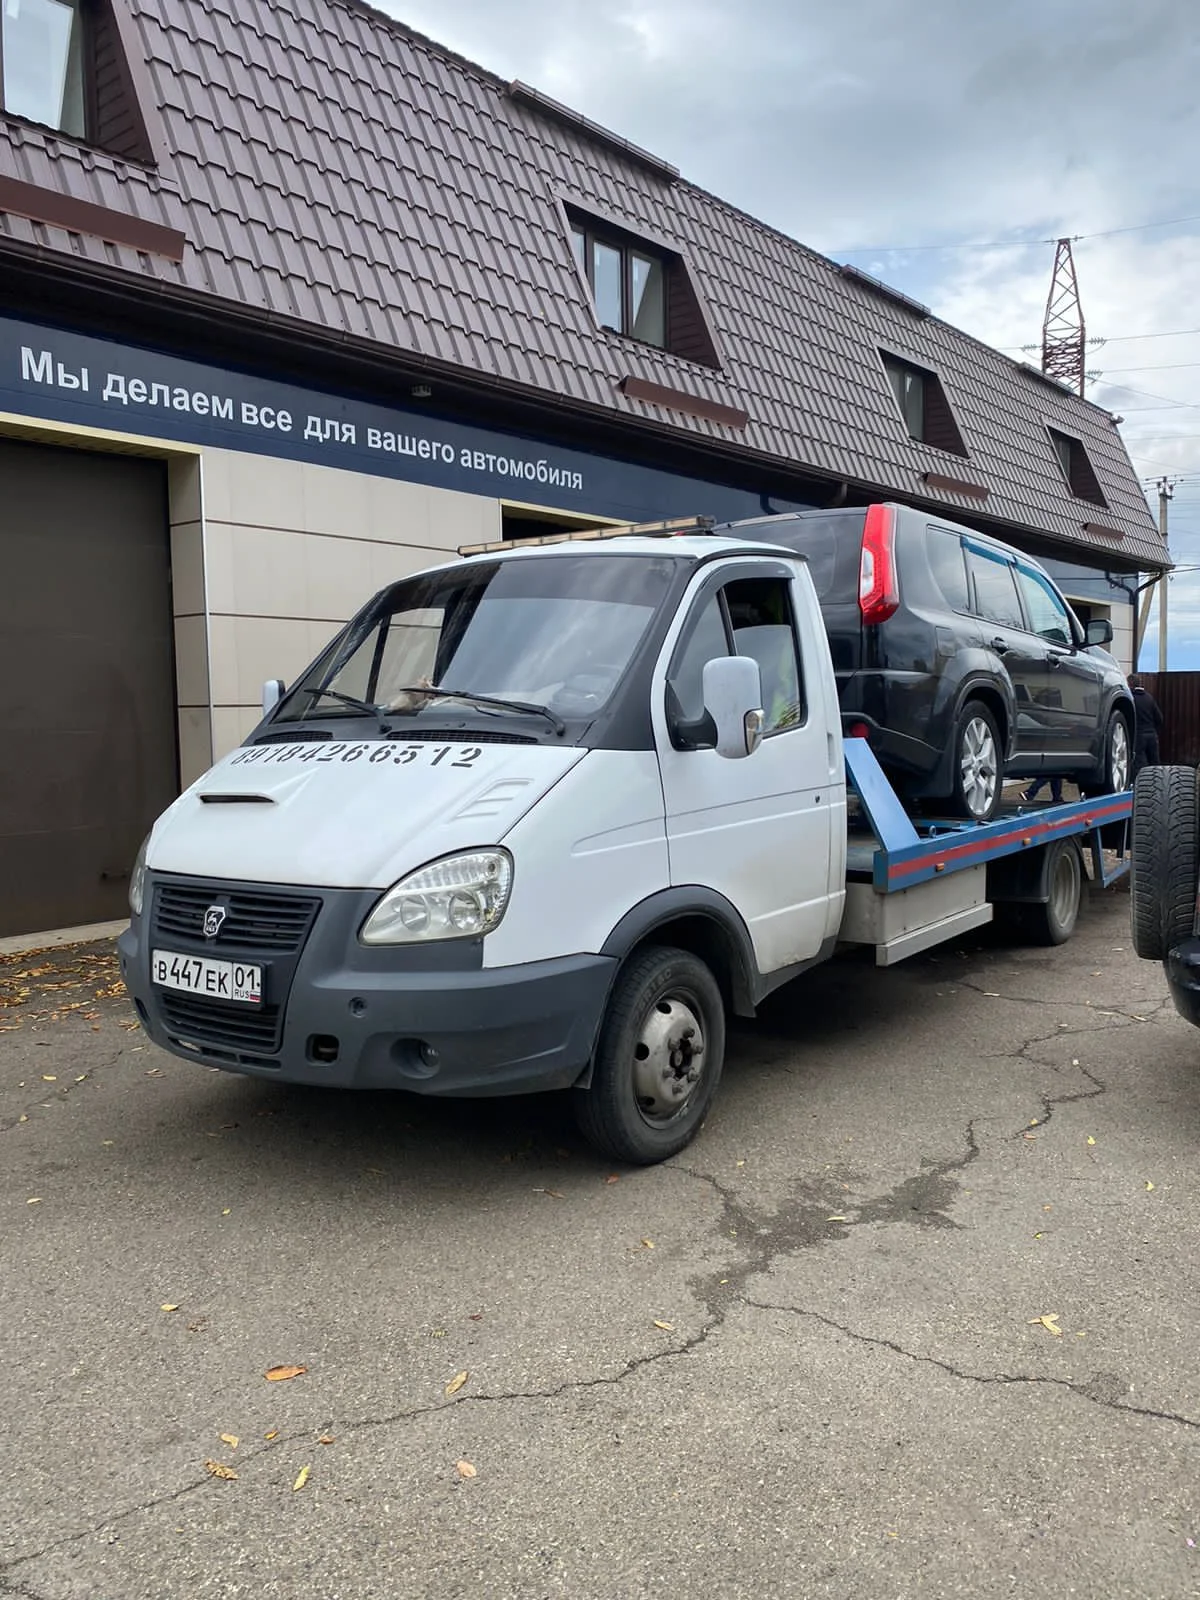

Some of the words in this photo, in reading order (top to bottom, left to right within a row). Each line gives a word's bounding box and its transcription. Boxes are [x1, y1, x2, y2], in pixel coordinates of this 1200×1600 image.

[20, 346, 90, 392] Мы
[102, 373, 234, 420] делаем
[241, 402, 293, 432] все
[303, 415, 356, 445] для
[367, 427, 455, 464] вашего
[460, 448, 583, 490] автомобиля
[230, 744, 483, 768] 89184266512
[234, 966, 256, 991] 01
[234, 988, 250, 999] RUS
